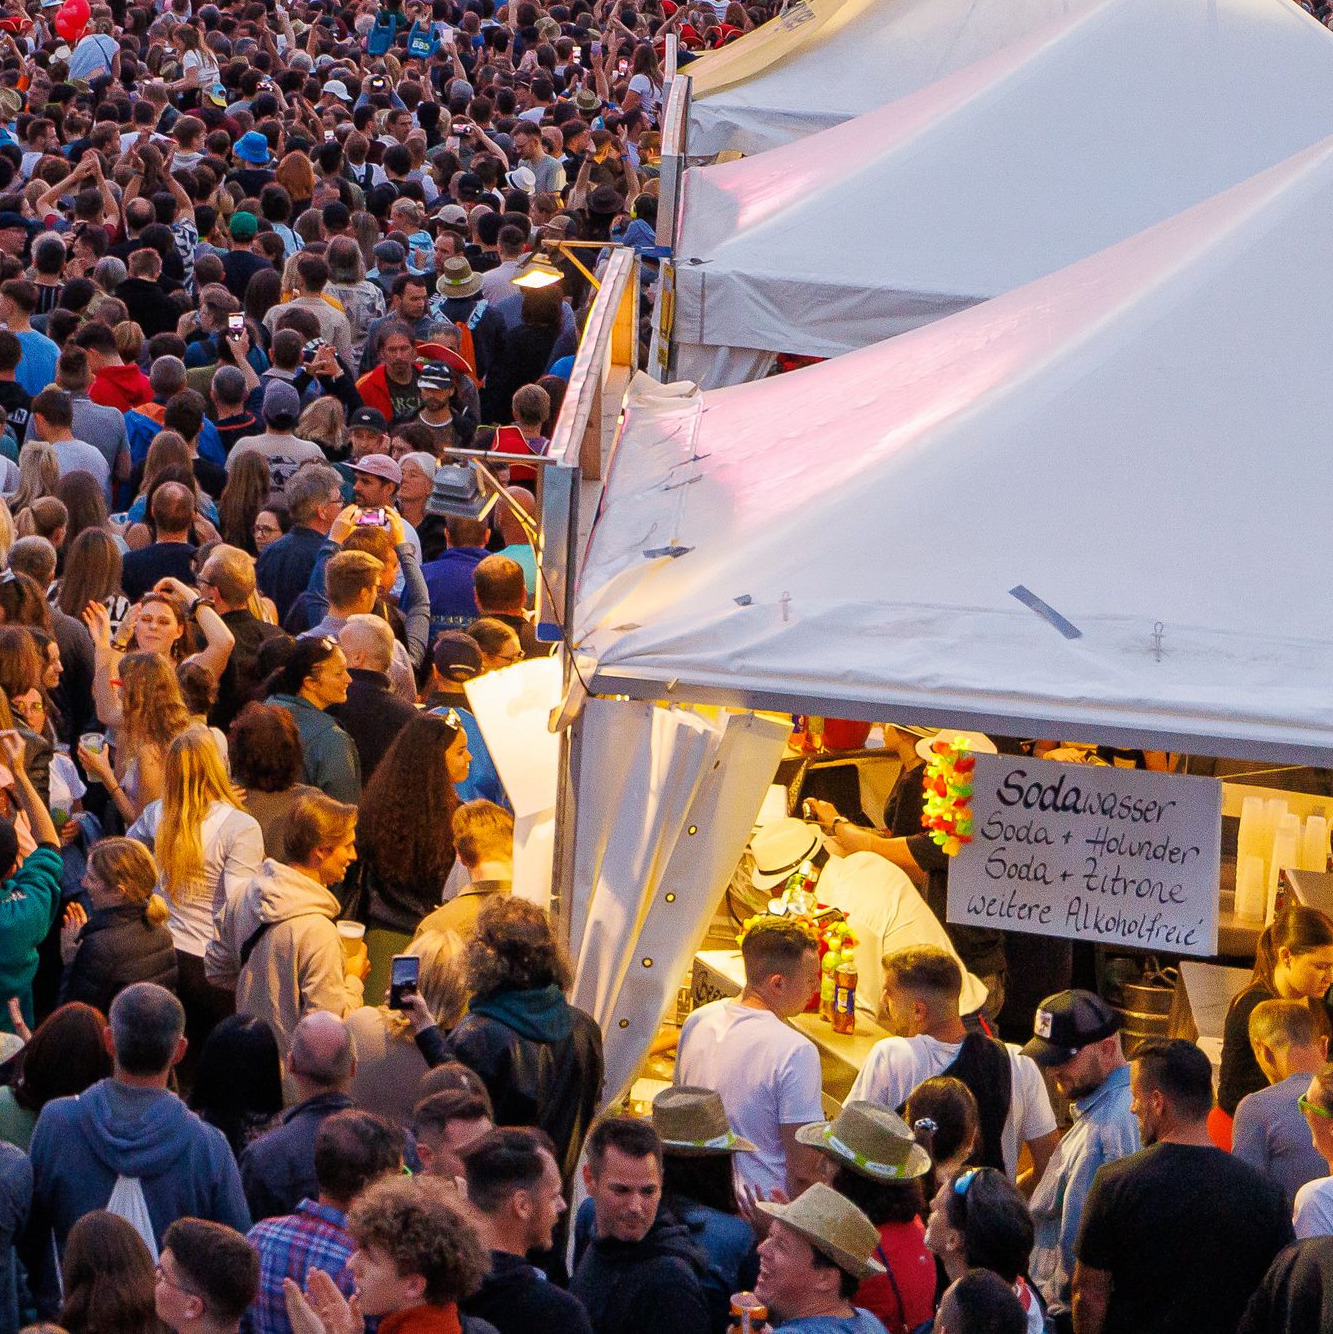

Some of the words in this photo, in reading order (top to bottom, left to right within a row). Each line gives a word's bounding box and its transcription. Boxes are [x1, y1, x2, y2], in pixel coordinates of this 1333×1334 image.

[995, 770, 1176, 823] Sodawasser
[981, 811, 1055, 844] Soda
[1062, 830, 1074, 844] +
[1085, 827, 1200, 865] Holunder
[985, 847, 1054, 884] Soda
[1060, 869, 1074, 882] +
[1083, 857, 1186, 903] Zitrone
[967, 890, 1052, 924] weitere
